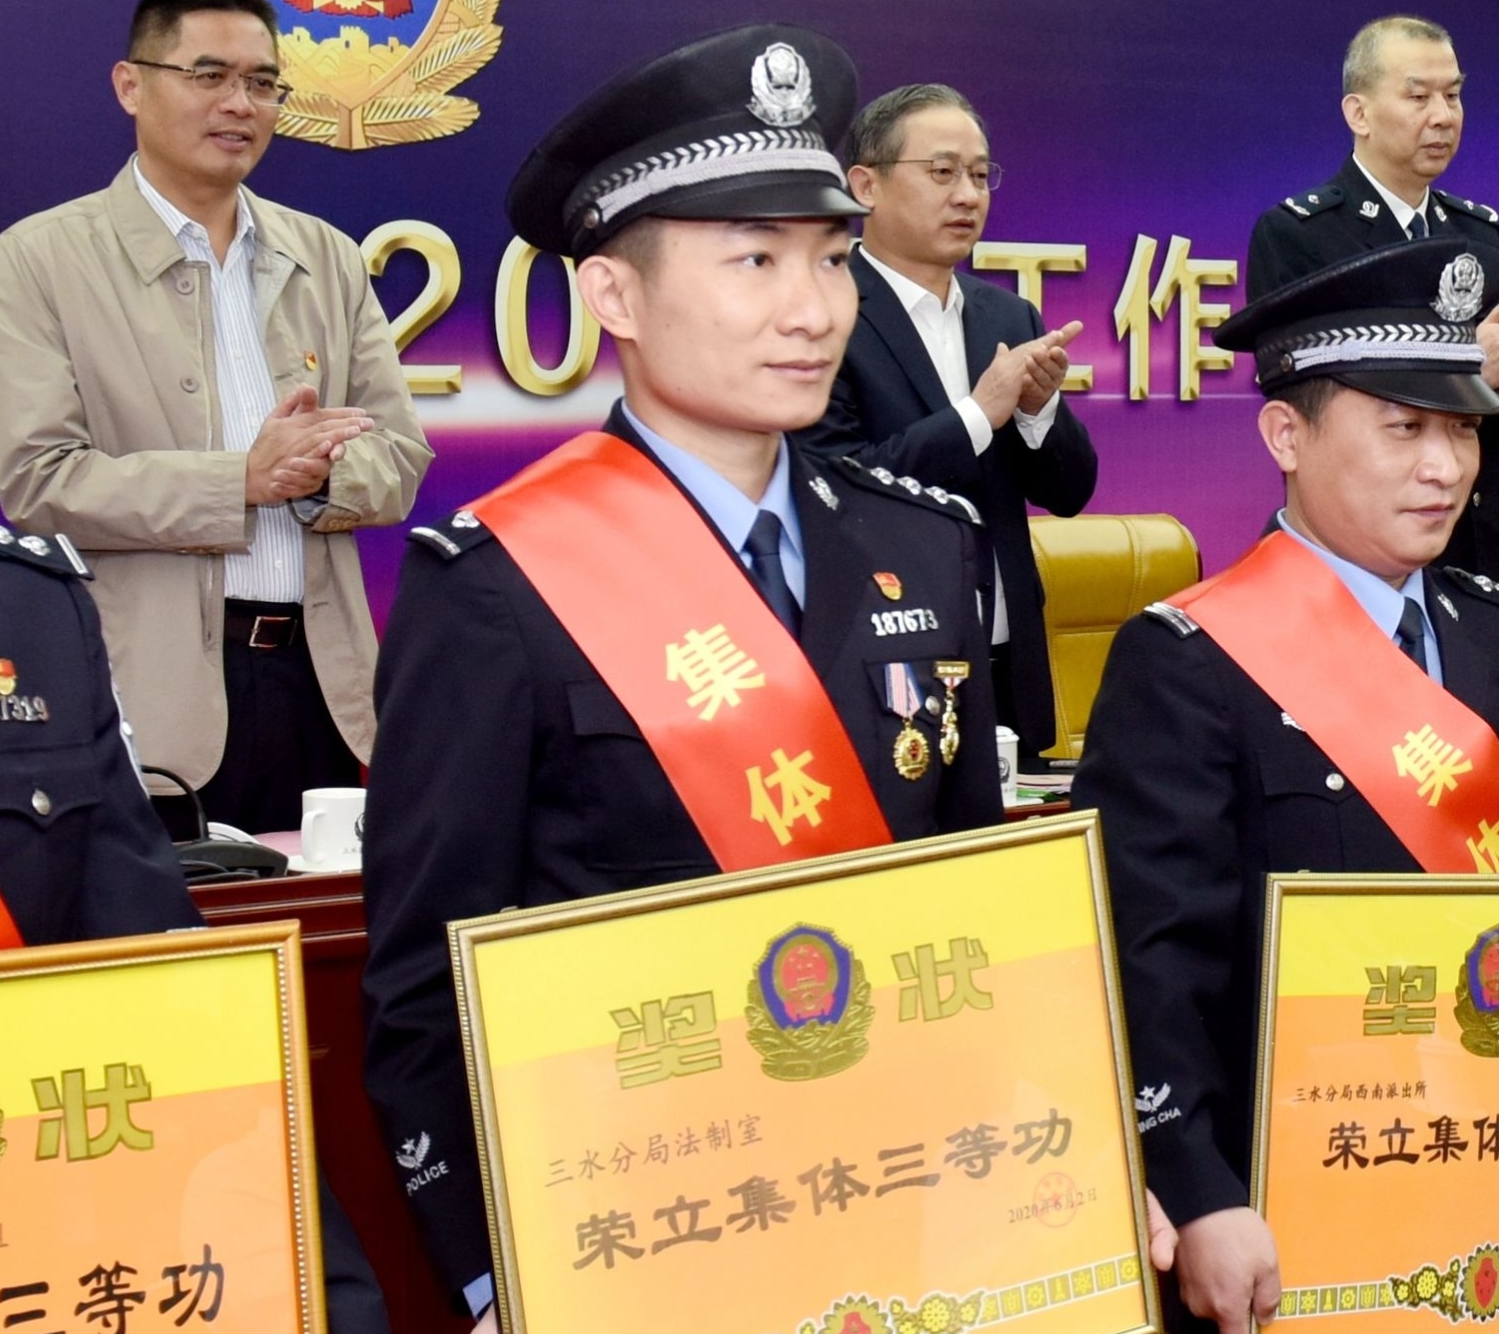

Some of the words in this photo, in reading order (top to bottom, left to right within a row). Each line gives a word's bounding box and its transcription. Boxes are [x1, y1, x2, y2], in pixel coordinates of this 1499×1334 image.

[870, 608, 939, 637] 187673
[664, 623, 832, 847] 集体
[1292, 1079, 1428, 1103] 三水分局西南派出所
[543, 1114, 765, 1189] 三水分局法制室
[572, 1108, 1075, 1270] 荣立集体三等功
